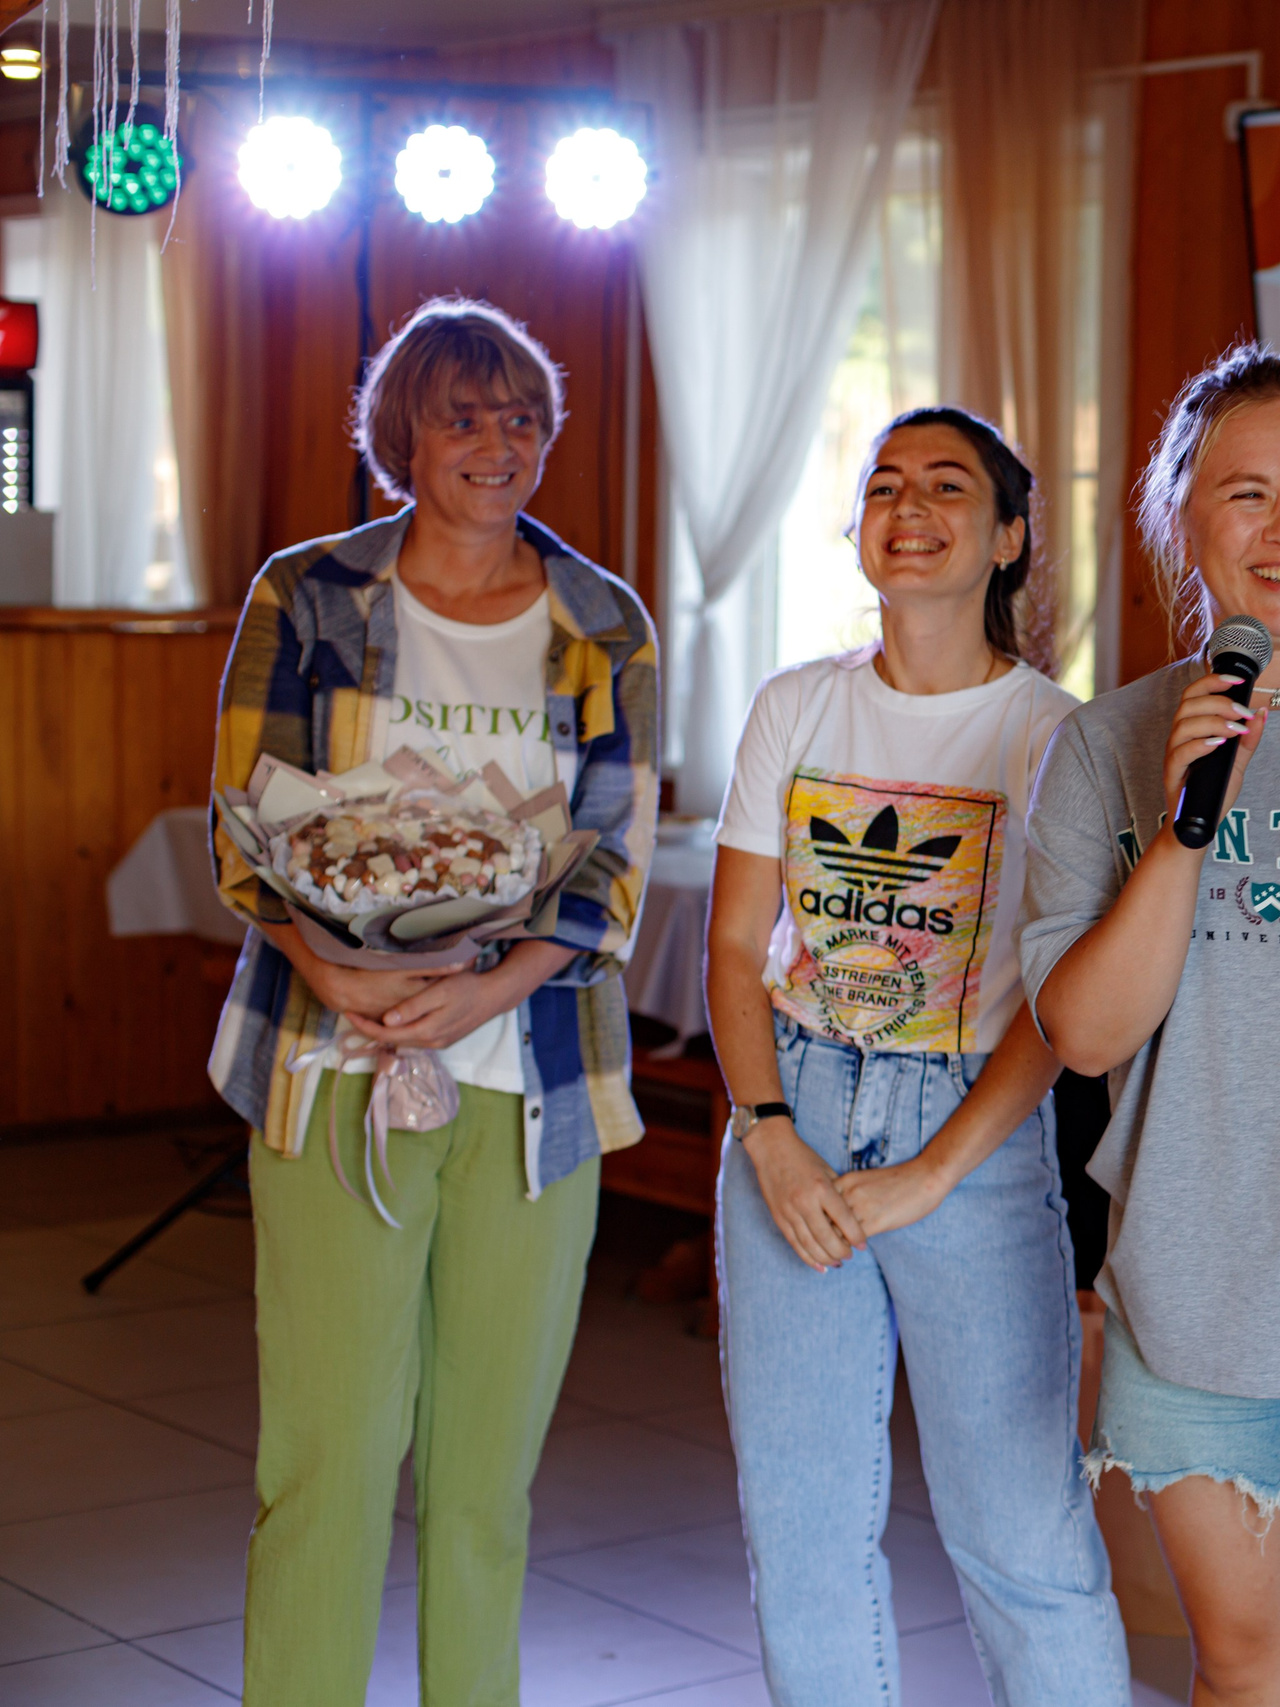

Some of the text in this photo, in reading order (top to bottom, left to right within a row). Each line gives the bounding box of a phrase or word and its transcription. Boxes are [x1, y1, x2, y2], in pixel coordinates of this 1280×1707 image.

[799, 888, 954, 935] adidas
[1209, 888, 1226, 900] 18
[825, 928, 927, 994] MARKE MIT DEN
[848, 989, 899, 1007] BRAND
[863, 998, 926, 1047] STRIPES
